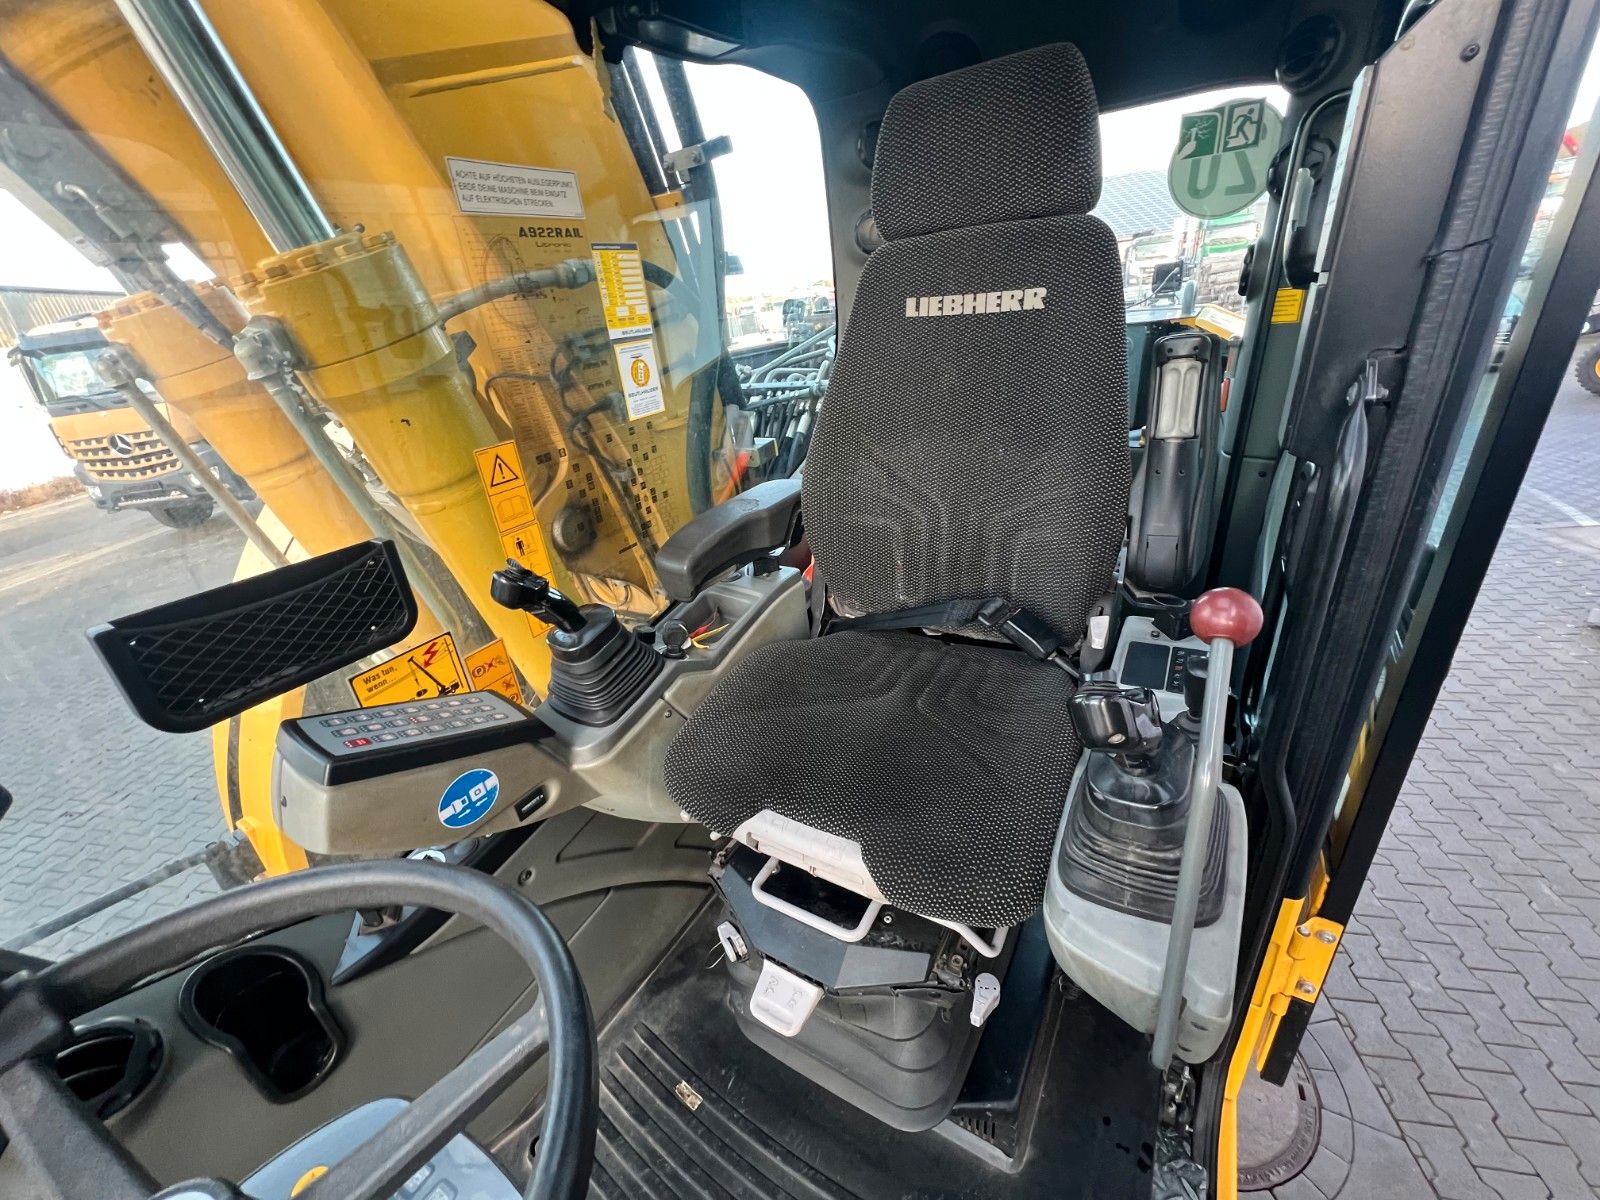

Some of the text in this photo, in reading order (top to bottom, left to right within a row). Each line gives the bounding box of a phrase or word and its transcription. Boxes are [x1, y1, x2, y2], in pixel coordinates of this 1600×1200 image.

[479, 172, 491, 181] AUF
[462, 194, 475, 202] AUF
[906, 287, 1047, 317] LIEBHERR
[362, 673, 381, 686] Was
